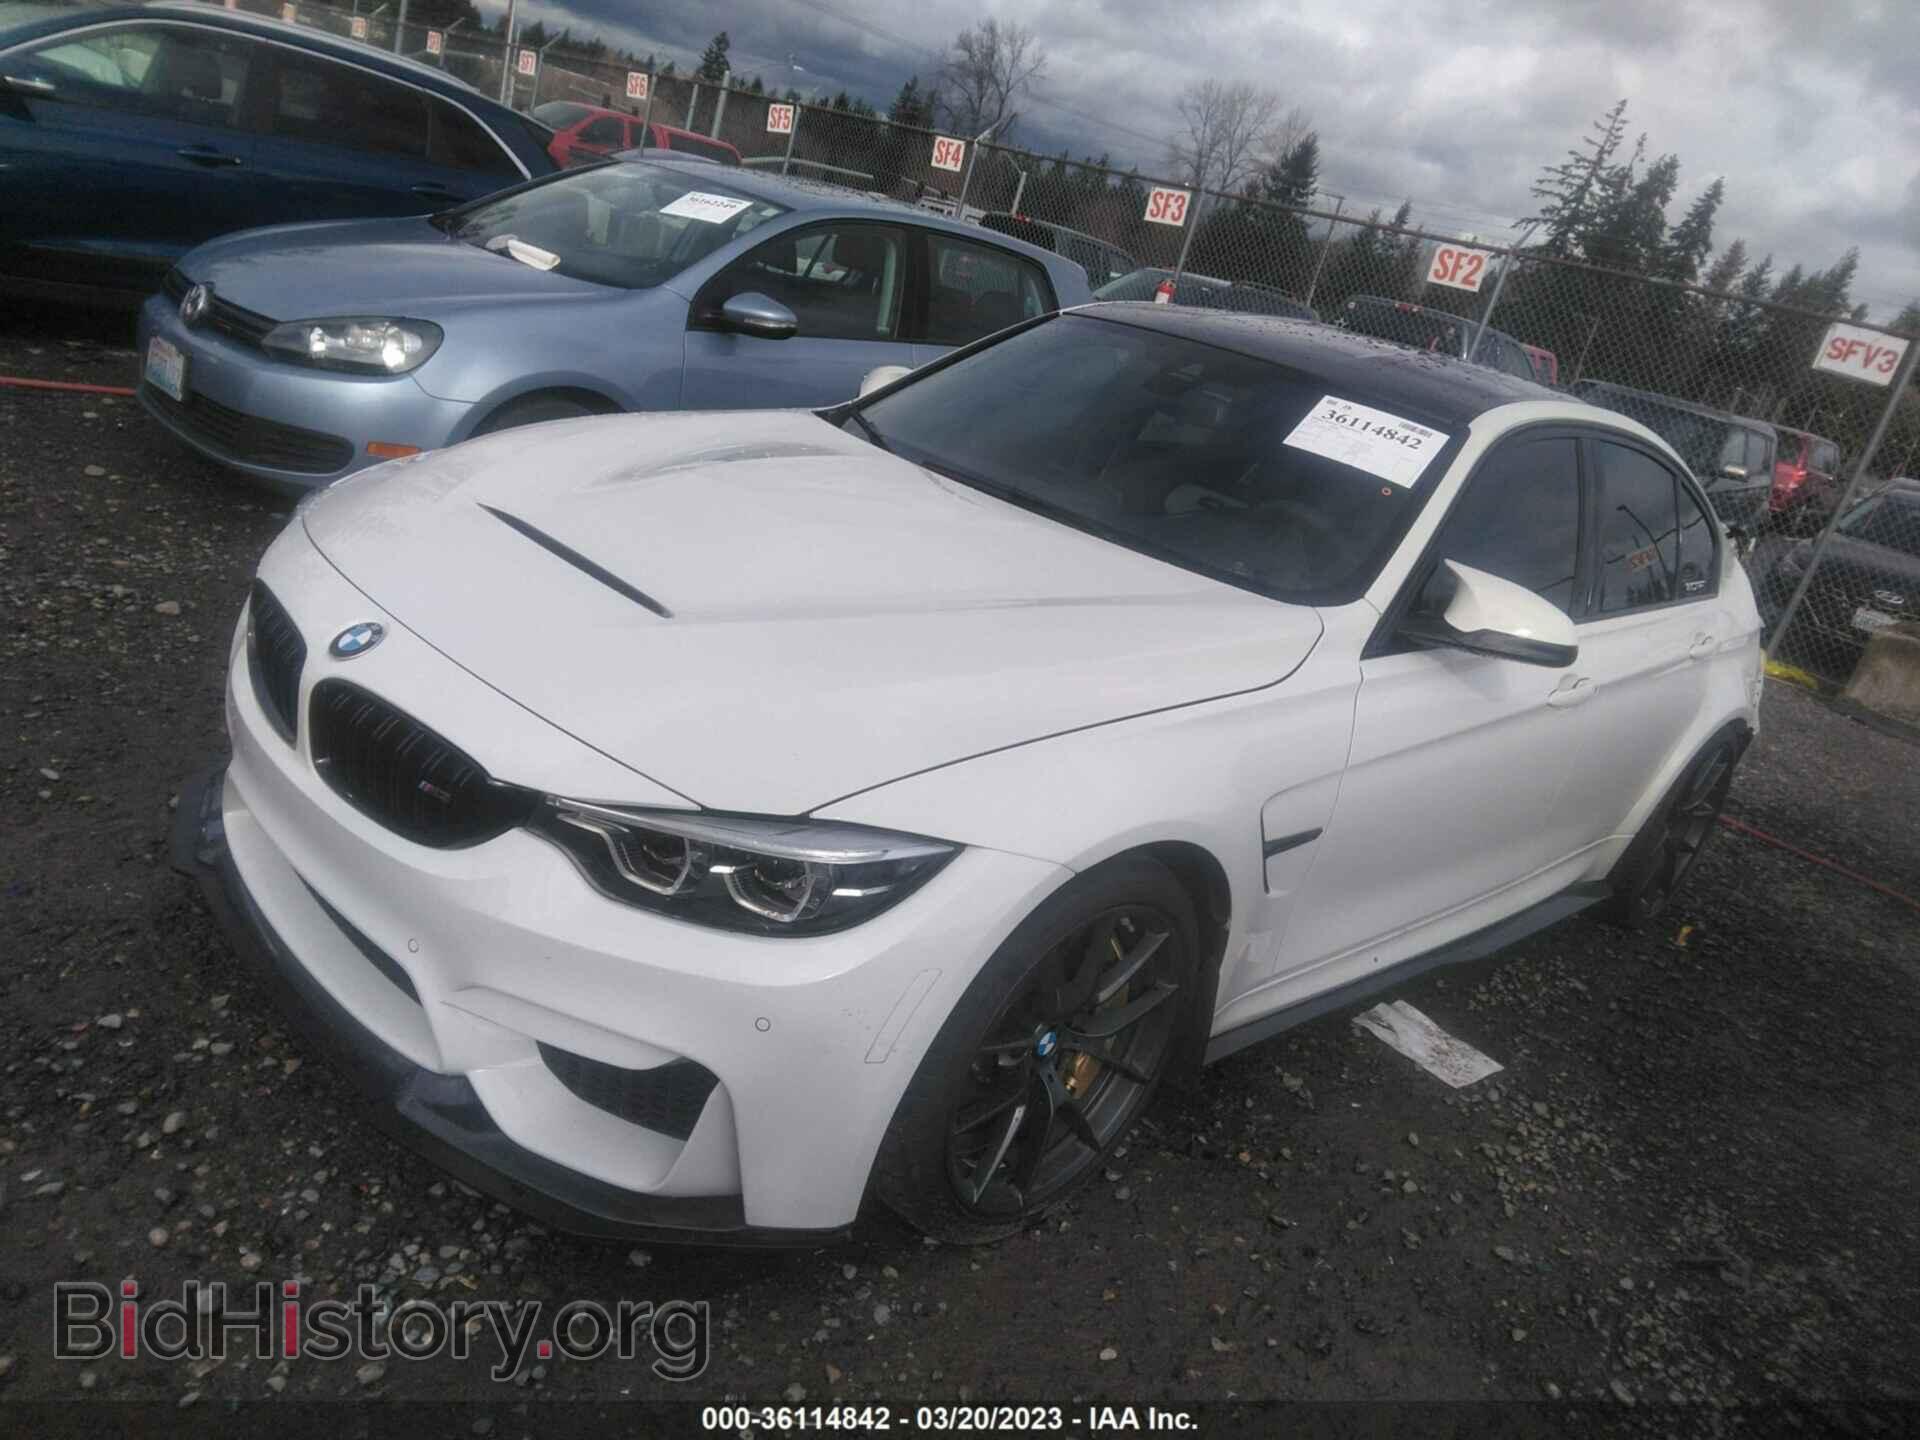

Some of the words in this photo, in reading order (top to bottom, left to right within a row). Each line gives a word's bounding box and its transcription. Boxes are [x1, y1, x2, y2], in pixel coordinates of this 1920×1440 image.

[770, 106, 792, 129] SF5
[935, 140, 962, 168] SF4
[1150, 191, 1186, 223] SF3
[1433, 249, 1484, 288] SF2
[1825, 337, 1899, 373] SFV3
[1321, 409, 1423, 450] 36114842
